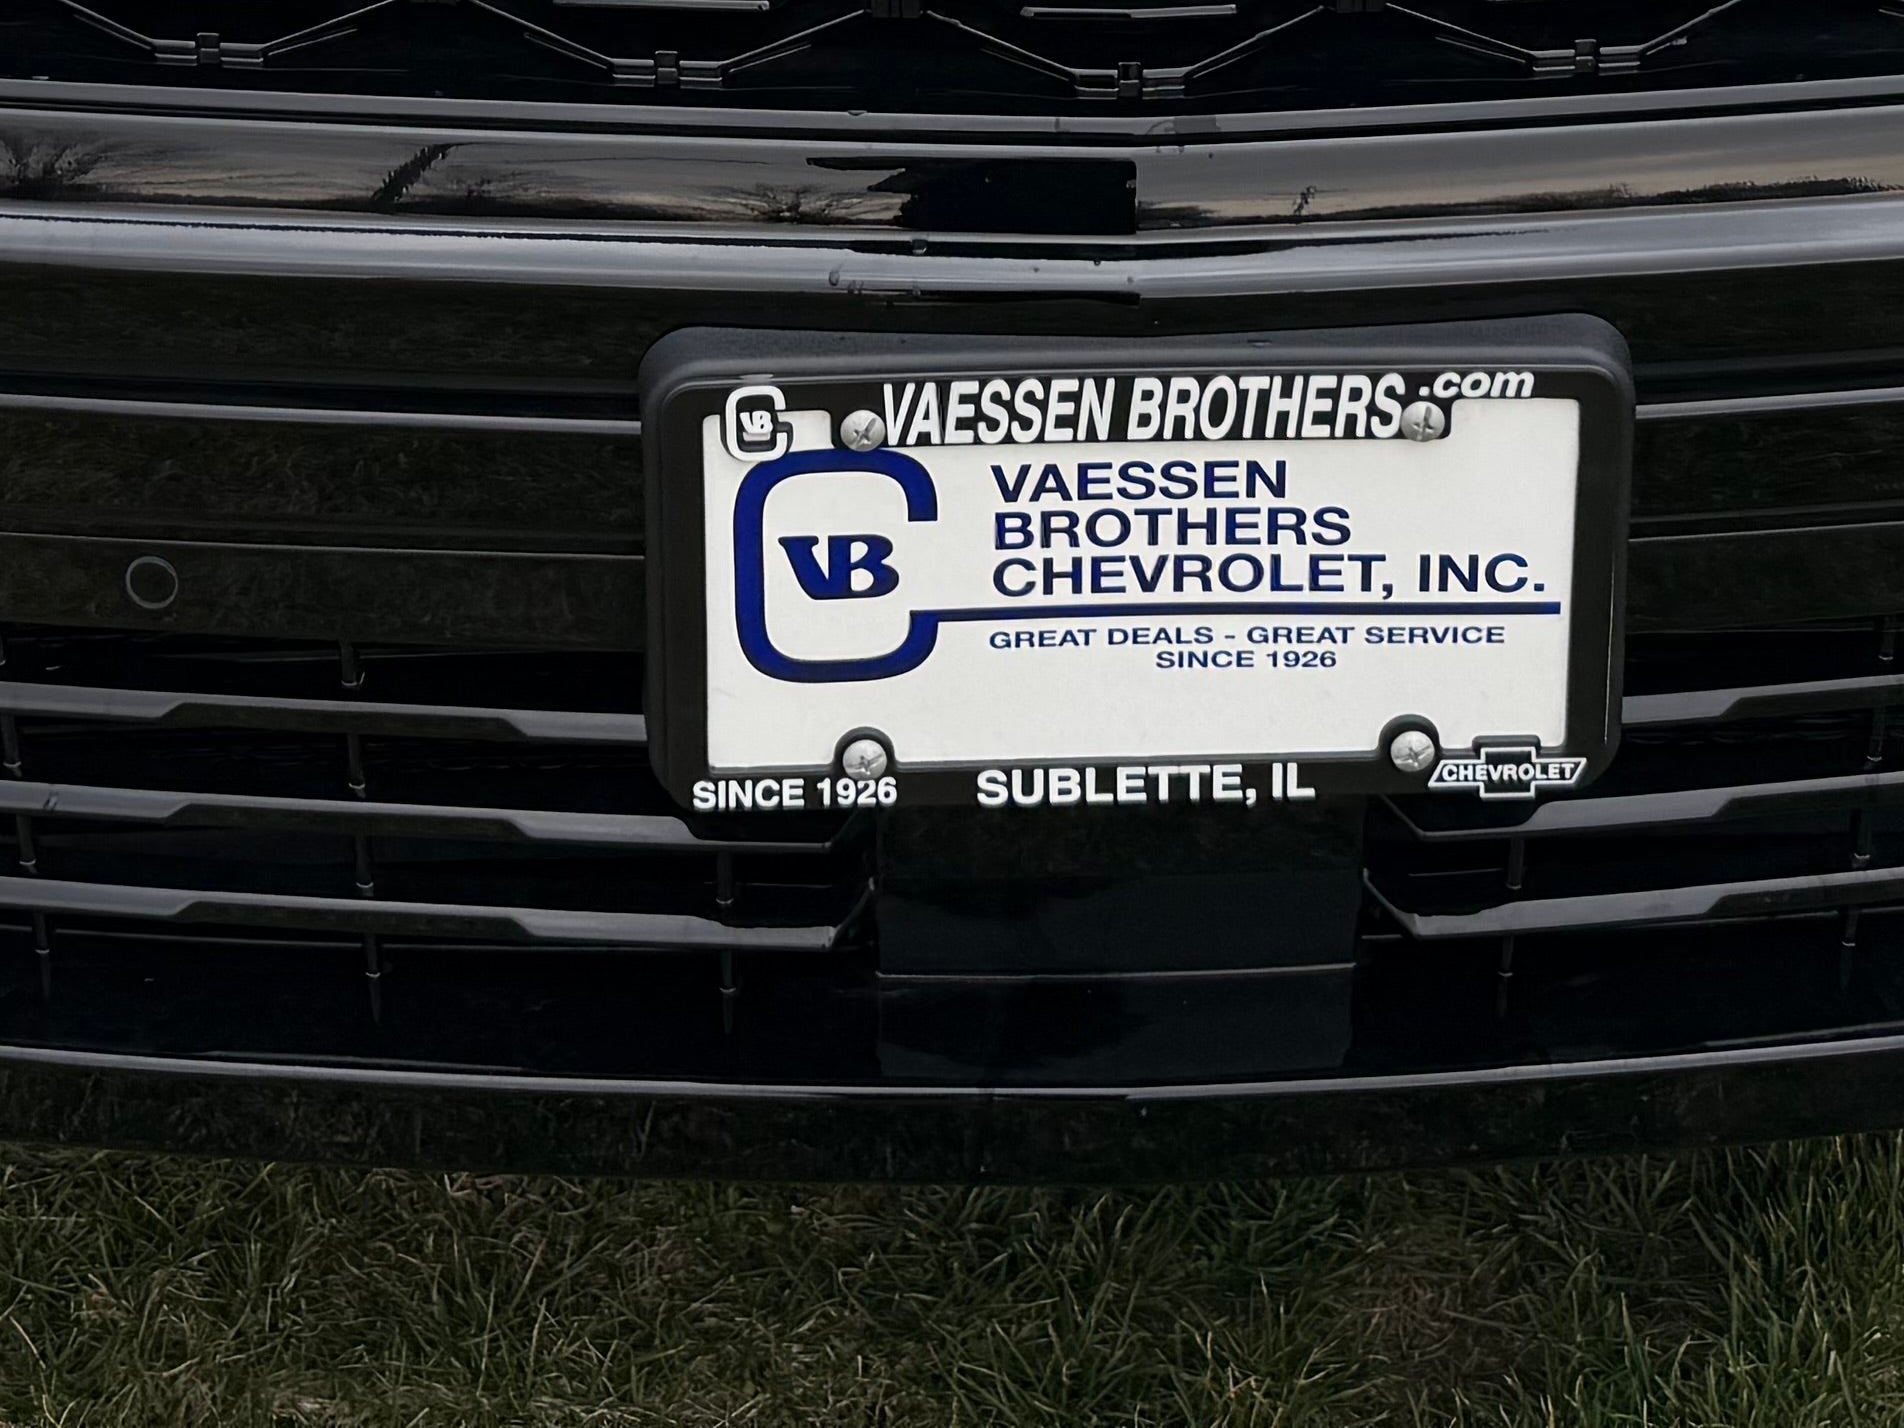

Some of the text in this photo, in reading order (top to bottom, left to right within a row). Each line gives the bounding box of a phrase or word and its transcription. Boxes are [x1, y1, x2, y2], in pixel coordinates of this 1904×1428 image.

[882, 377, 1117, 446] VAESSEN
[1126, 372, 1406, 442] BROTHERS
[990, 459, 1287, 503] VAESSEN
[994, 505, 1352, 551] BROTHERS
[777, 533, 900, 601] VB
[992, 552, 1546, 601] CHEVROLET, INC.
[989, 628, 1098, 649] GREAT
[1107, 626, 1214, 646] DEALS
[1246, 625, 1356, 645] GREAT
[1363, 625, 1506, 645] SERVICE
[1155, 650, 1338, 669] SINCE 1926
[692, 775, 898, 810] SINCE 1926
[976, 761, 1317, 808] SUBLETTE, IL
[1441, 762, 1575, 782] CHEVROLET
